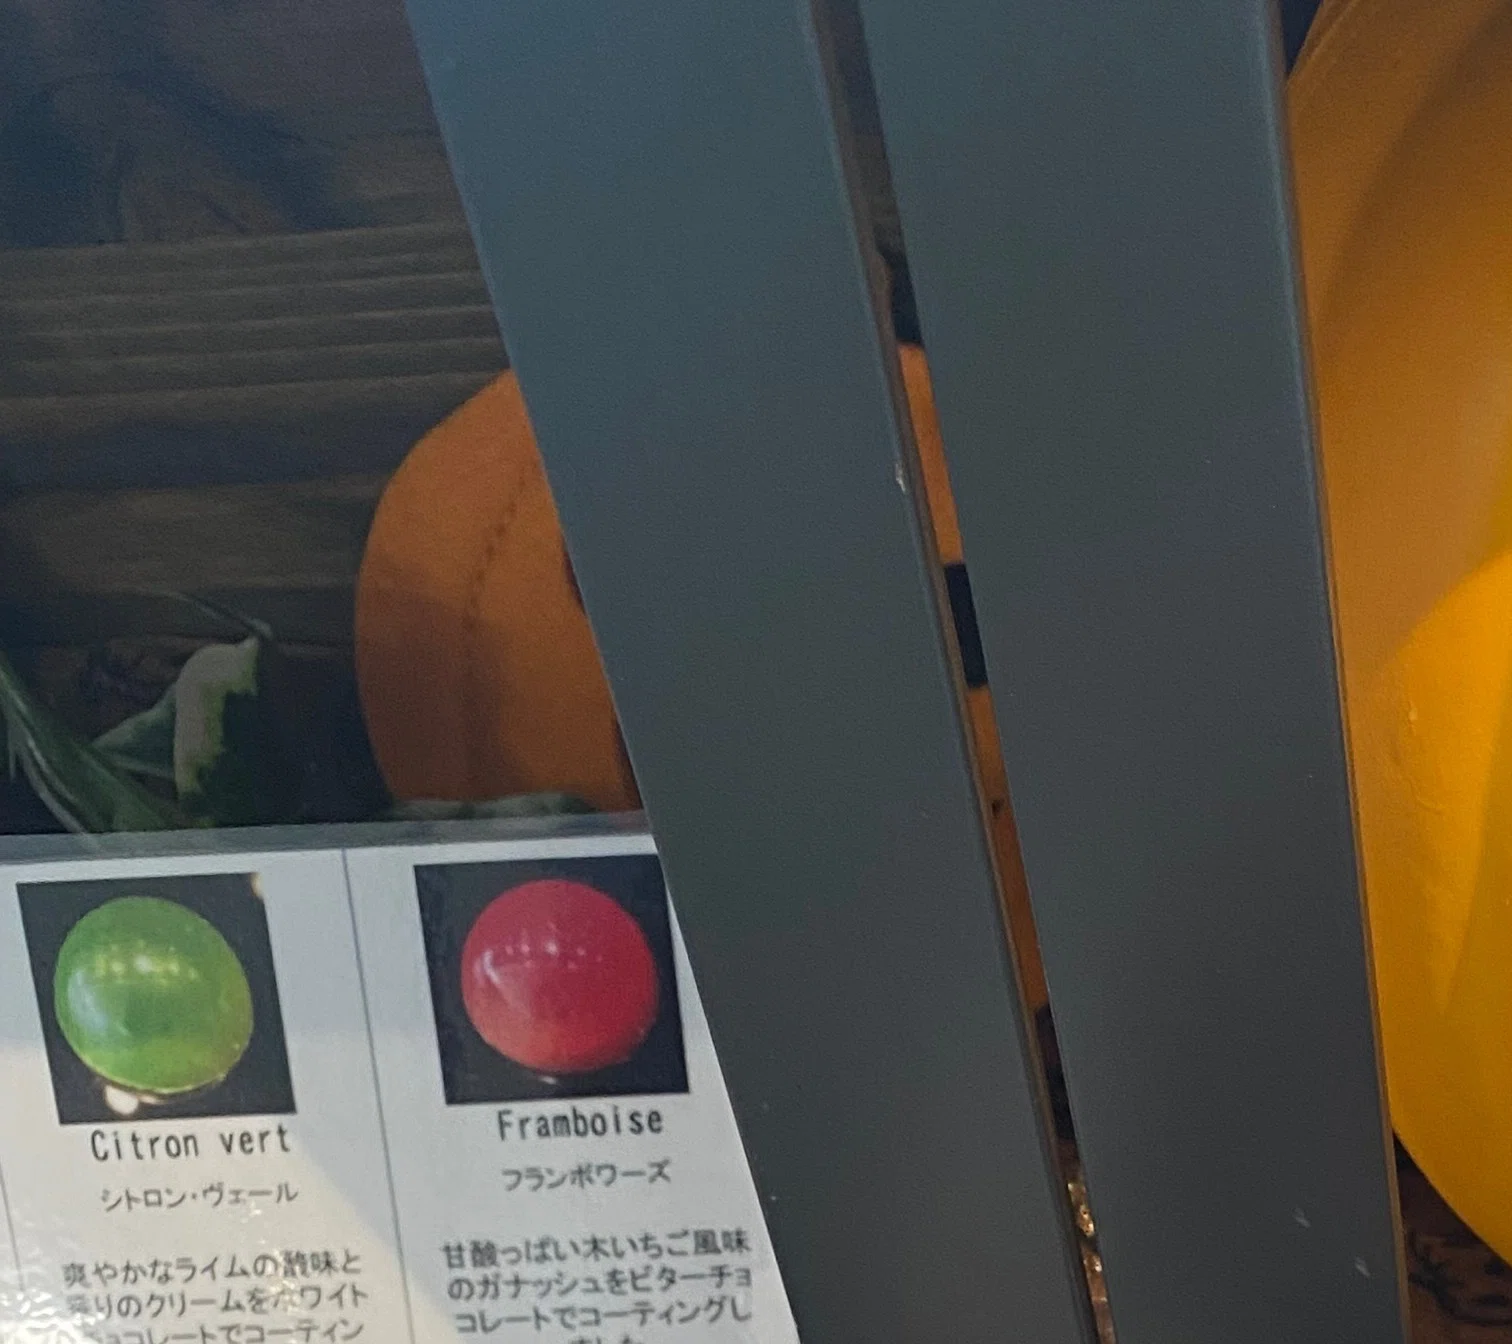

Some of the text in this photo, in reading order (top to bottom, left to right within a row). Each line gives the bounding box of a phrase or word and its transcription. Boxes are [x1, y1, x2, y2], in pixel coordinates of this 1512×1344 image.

[91, 1123, 292, 1161] Citron vert
[497, 1106, 665, 1141] Framboise
[502, 1158, 673, 1193] フランボワーズ
[101, 1181, 299, 1212] シトロン・ヴェール
[440, 1228, 753, 1270] 甘酸っぱい木いちご風味
[447, 1264, 753, 1302] のガナッシュをビターチョ
[455, 1298, 753, 1335] コレートでコーティングし
